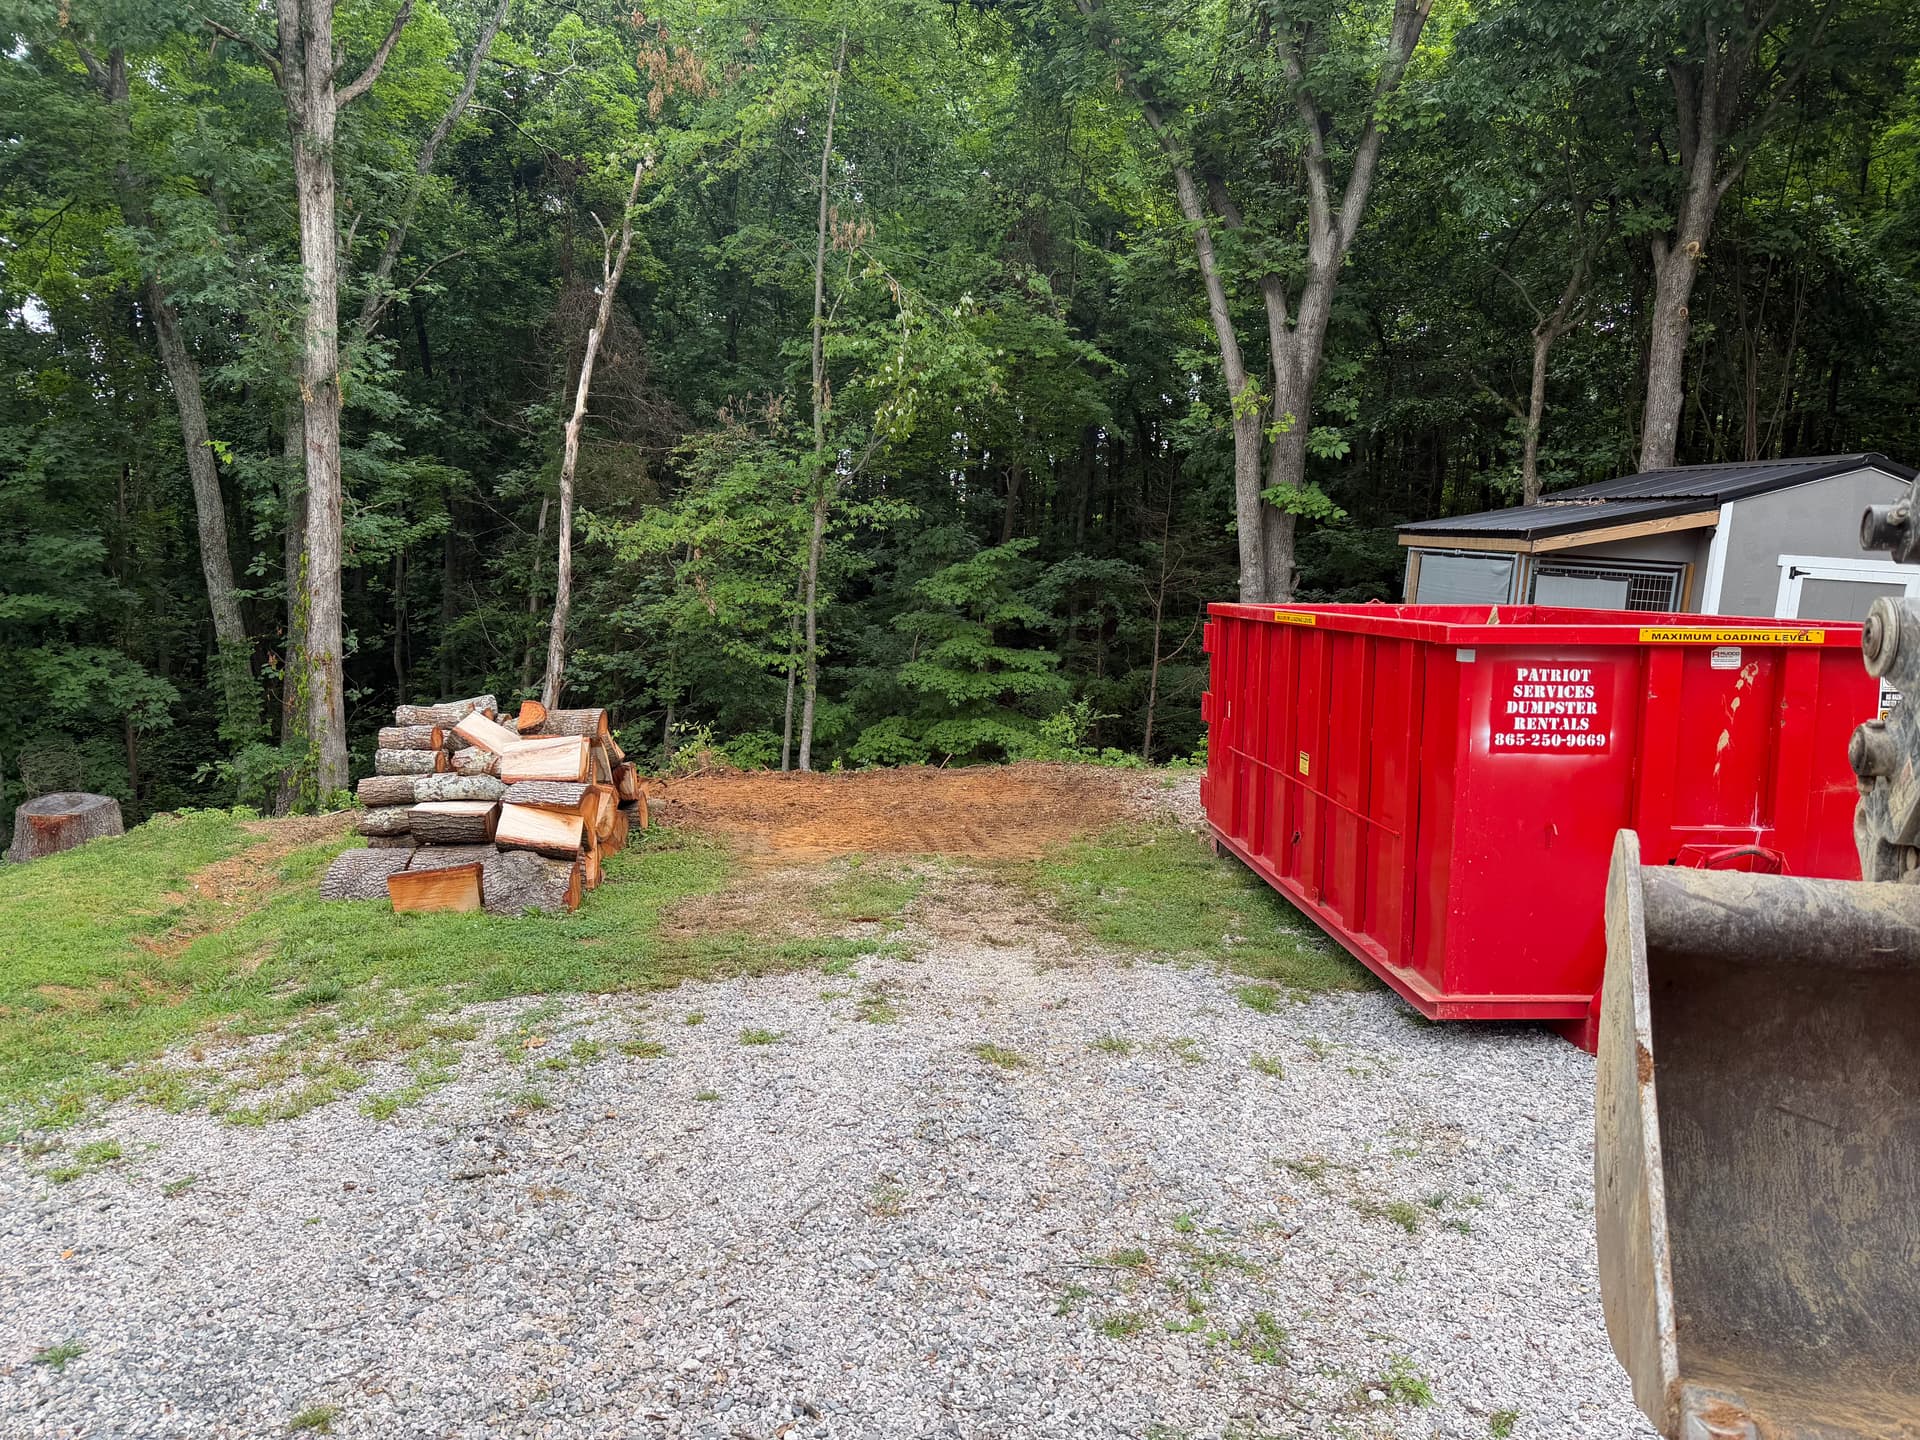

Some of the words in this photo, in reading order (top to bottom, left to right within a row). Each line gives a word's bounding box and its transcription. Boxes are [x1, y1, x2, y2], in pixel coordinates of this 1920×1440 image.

[1651, 633, 1712, 641] MAXIMUM
[1716, 633, 1770, 641] LOADING
[1774, 634, 1812, 642] LEVEL
[1517, 668, 1592, 682] PATRIOT
[1513, 685, 1595, 698] SERVICES
[1506, 701, 1598, 714] DUMPSTER
[1513, 717, 1590, 730] RENTALS
[1494, 733, 1606, 746] 865-250-9669
